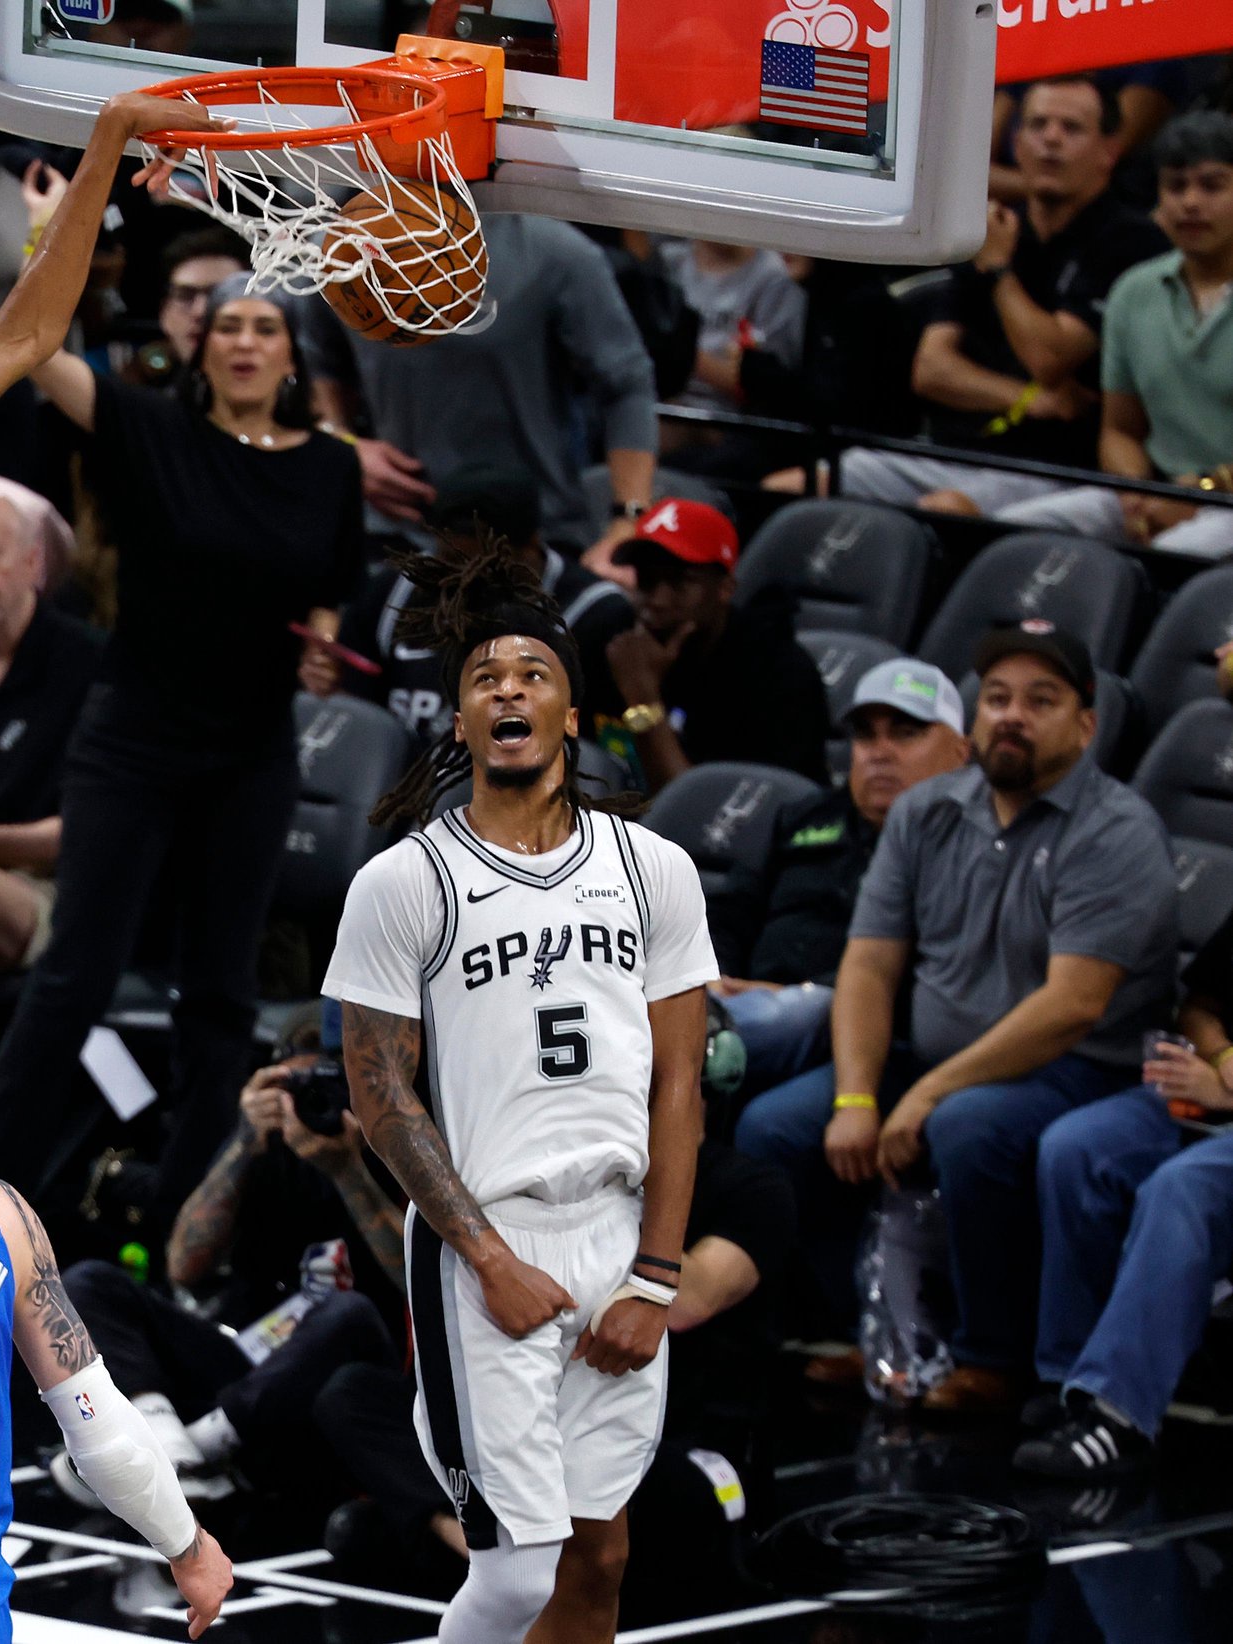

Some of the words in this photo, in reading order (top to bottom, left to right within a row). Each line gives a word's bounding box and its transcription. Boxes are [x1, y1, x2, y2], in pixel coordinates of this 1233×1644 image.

[582, 889, 619, 898] LEDGER
[462, 925, 637, 991] SPURS
[533, 1001, 593, 1082] 5
